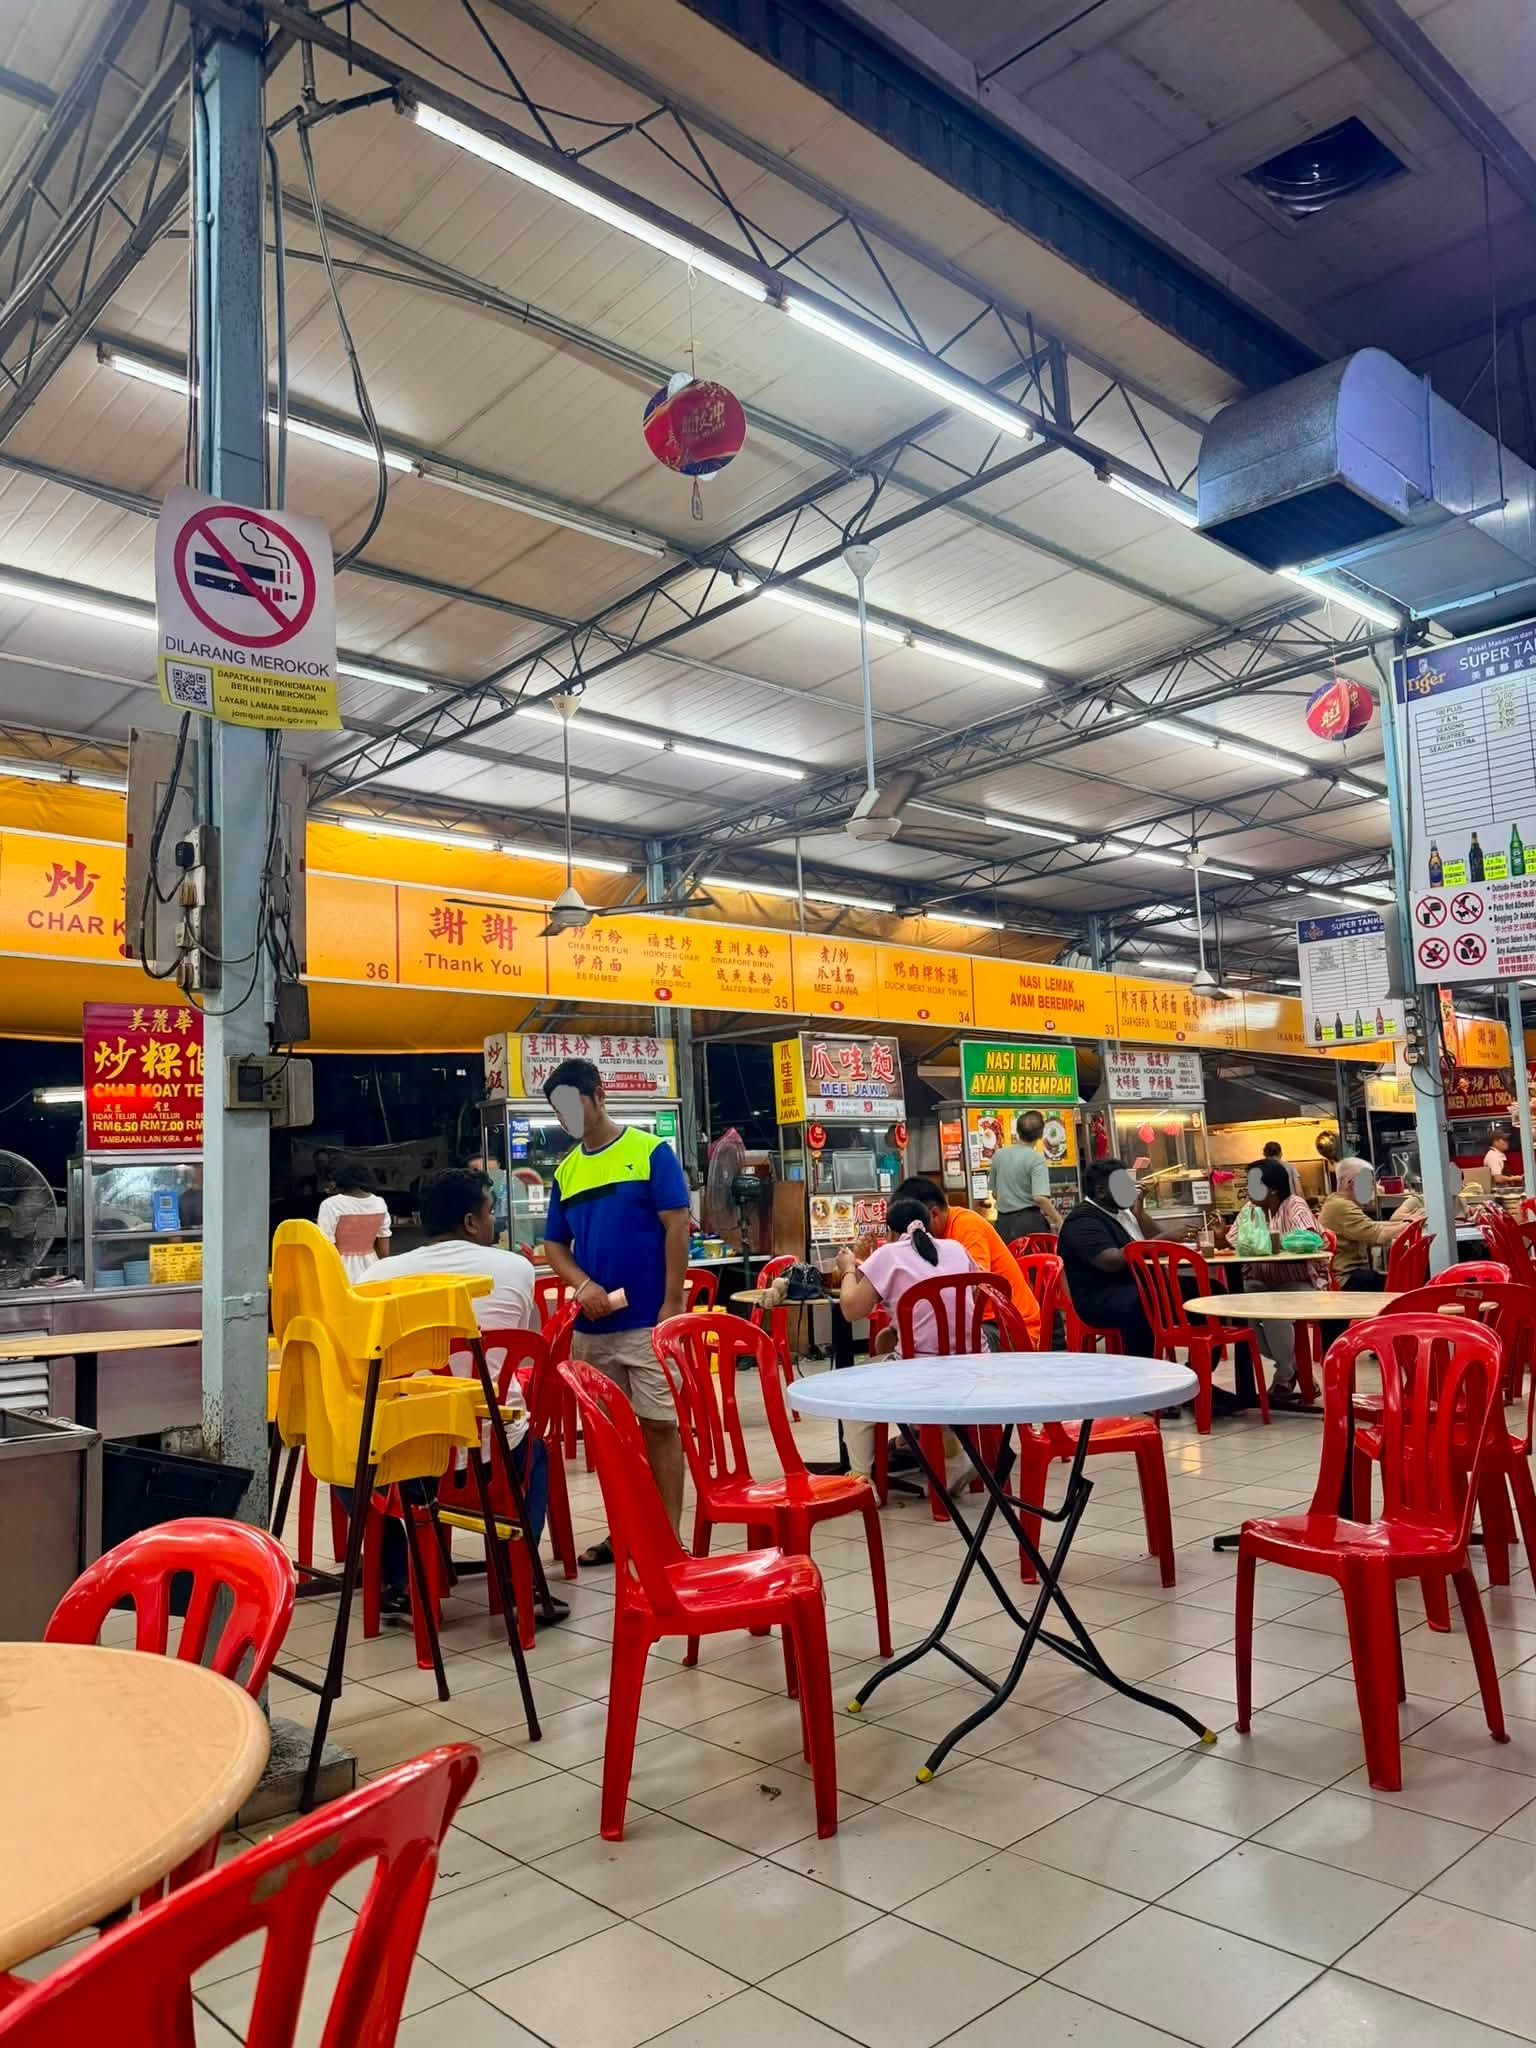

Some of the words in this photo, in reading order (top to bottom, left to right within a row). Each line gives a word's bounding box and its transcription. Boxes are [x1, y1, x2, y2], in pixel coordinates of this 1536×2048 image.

[165, 635, 246, 664] DILARANG
[251, 653, 330, 678] MEROKOK
[1460, 645, 1511, 671] SUPER
[217, 670, 261, 684] DAPATKAN
[263, 677, 327, 693] PERKHIDMATAN
[231, 681, 275, 695] BERHENTI
[275, 689, 317, 702] MEROKOK
[219, 695, 249, 707] LAYARI
[250, 700, 280, 712] LAMAN
[44, 860, 101, 909] 炒
[27, 910, 105, 936] CHAR
[428, 906, 518, 951] 謝謝
[1331, 920, 1357, 931] SUPER
[568, 942, 591, 951] CHAR
[365, 962, 390, 980] 36
[423, 952, 484, 974] Thank
[490, 958, 523, 977] You
[721, 984, 746, 993] SALTED
[814, 983, 832, 994] MEE
[835, 985, 859, 996] JAWA
[884, 980, 906, 992] DUCK
[907, 983, 926, 993] MEAT
[1019, 974, 1041, 990] NASI
[1045, 977, 1075, 993] LEMAK
[774, 995, 789, 1009] 35
[1010, 993, 1036, 1009] AYAM
[1038, 995, 1085, 1013] BEREMPAH
[128, 1007, 194, 1036] 美麗華
[958, 1011, 970, 1024] 34
[1104, 1023, 1115, 1036] 33
[780, 1043, 793, 1094] 爪哇面
[986, 1051, 1015, 1073] NASI
[1018, 1052, 1057, 1073] LEMAK
[93, 1082, 137, 1098] CHAR
[140, 1082, 181, 1098] KOAY
[821, 1081, 849, 1096] MEE
[853, 1082, 889, 1098] JAWA
[970, 1074, 1006, 1095] AYAM
[1010, 1075, 1072, 1096] BEREMPAH
[781, 1096, 798, 1107] MEE
[92, 1112, 113, 1120] TIDAK
[115, 1112, 137, 1120] TELUR
[142, 1112, 159, 1120] ADA
[159, 1112, 181, 1120] TELUR
[780, 1109, 800, 1121] JAWA
[93, 1120, 138, 1132] RM6.50
[140, 1120, 184, 1132] RM7.00
[99, 1135, 142, 1144] TAMBAHAN
[143, 1135, 161, 1143] LAIN
[162, 1134, 180, 1143] KIRA
